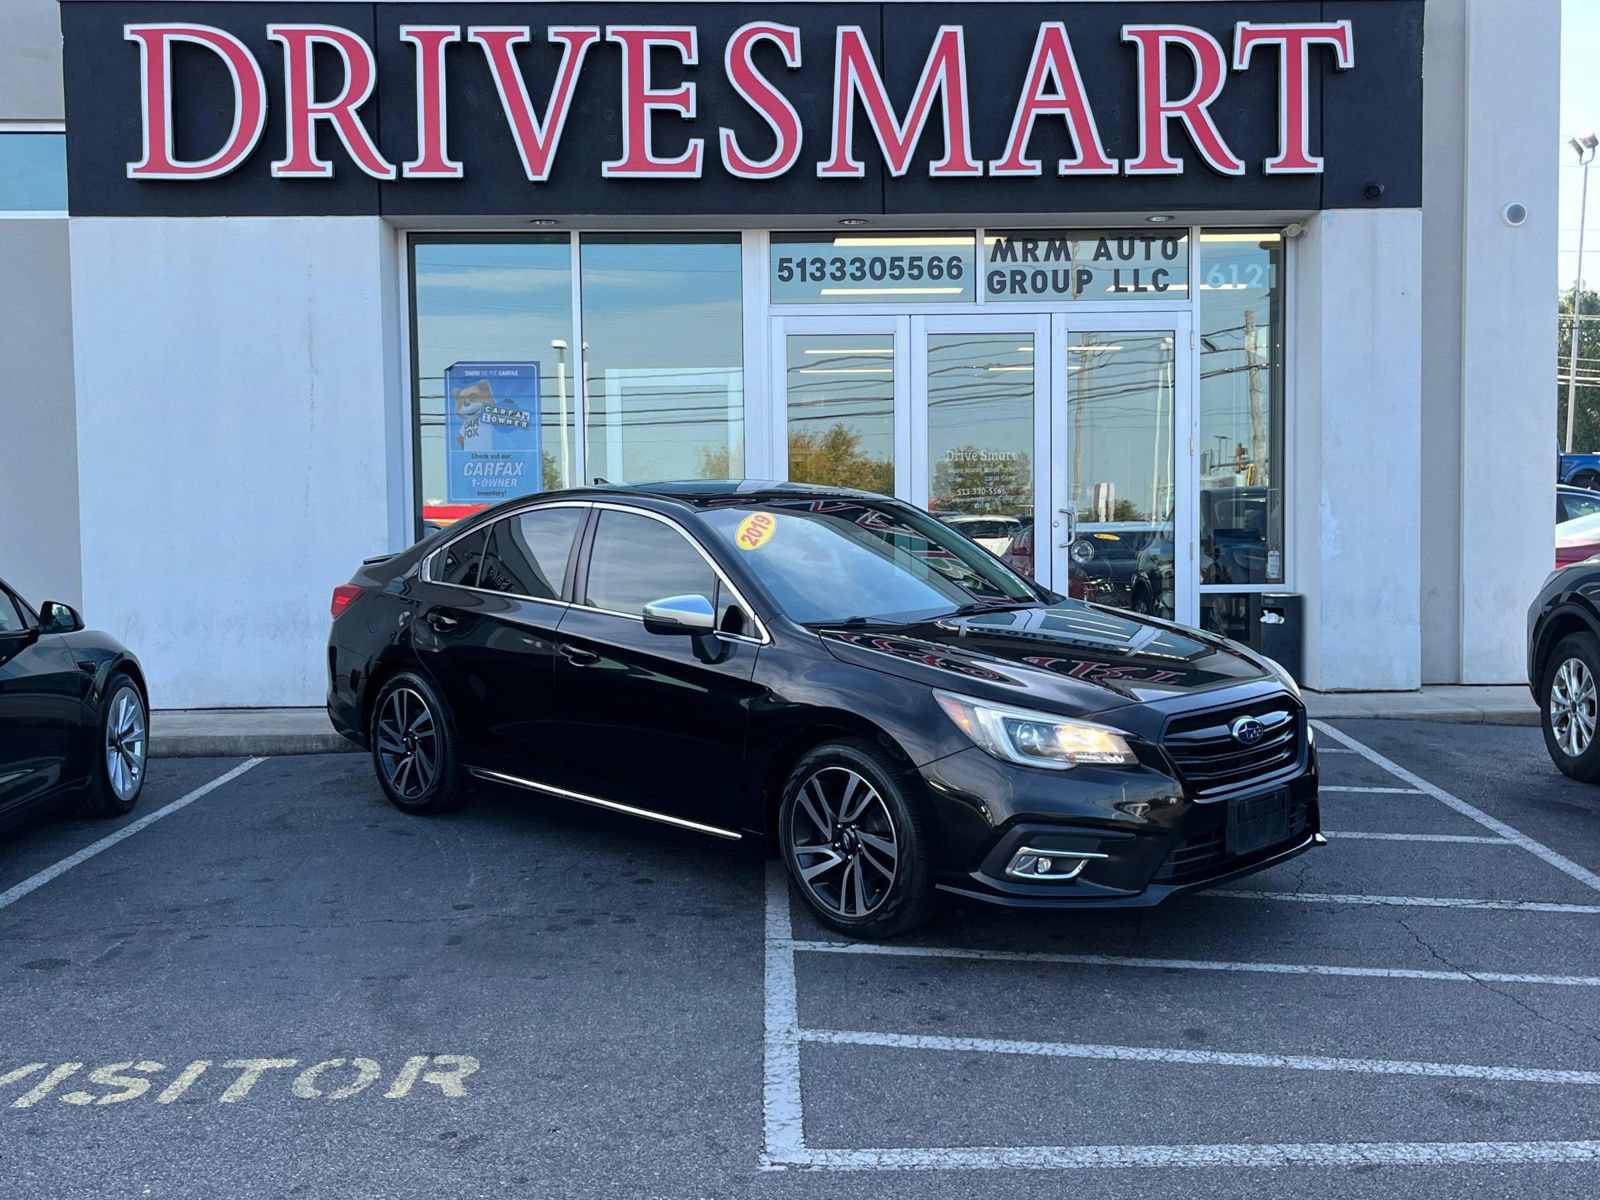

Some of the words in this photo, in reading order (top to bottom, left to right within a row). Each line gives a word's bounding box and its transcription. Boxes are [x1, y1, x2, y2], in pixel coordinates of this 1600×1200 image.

[123, 20, 1355, 183] DRIVESMART
[989, 238, 1072, 262] MRM
[1092, 236, 1179, 261] AUTO
[777, 255, 964, 283] 5133305566
[987, 268, 1093, 294] GROUP
[1113, 268, 1169, 293] LLC
[1206, 263, 1277, 289] 6121
[485, 406, 530, 420] CARFAX
[491, 415, 529, 428] OWNER
[945, 450, 978, 462] Drive
[980, 449, 1018, 461] Smart
[463, 462, 524, 476] CARFAX
[741, 515, 771, 546] 2019
